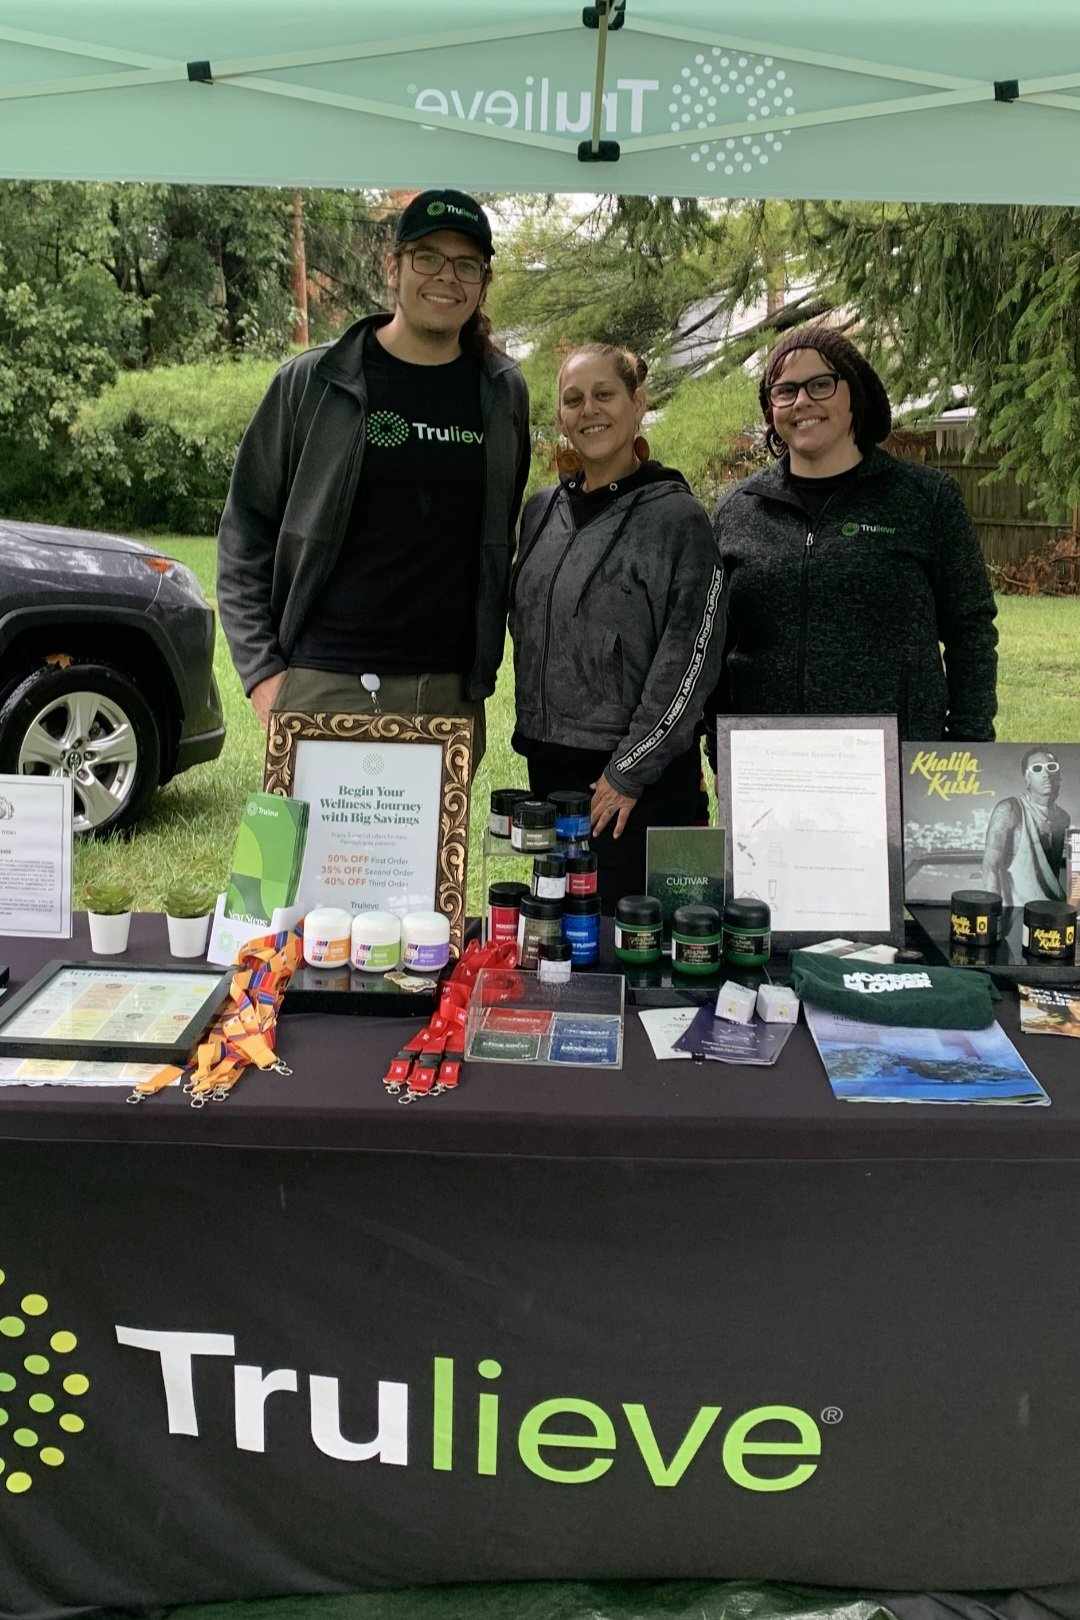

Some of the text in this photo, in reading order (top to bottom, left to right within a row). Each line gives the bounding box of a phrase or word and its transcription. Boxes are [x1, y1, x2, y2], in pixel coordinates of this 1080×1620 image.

[412, 422, 484, 444] Truliev
[632, 729, 664, 760] ARMOUR
[664, 696, 686, 726] UNDER
[682, 652, 703, 695] ARMOUR
[697, 614, 711, 650] UNDER
[708, 569, 722, 612] ARMOUR
[910, 751, 980, 779] Khalifa
[338, 785, 406, 798] Begin Your
[928, 774, 995, 800] Kush
[320, 798, 423, 814] Wellness Journey
[321, 811, 420, 826] with Big Savings
[350, 855, 369, 864] OFF
[387, 857, 409, 865] Order
[344, 866, 363, 875] OFF
[364, 867, 391, 876] Second
[392, 868, 414, 877] Order
[347, 878, 367, 886] OFF
[666, 876, 709, 886] CULTIVAR
